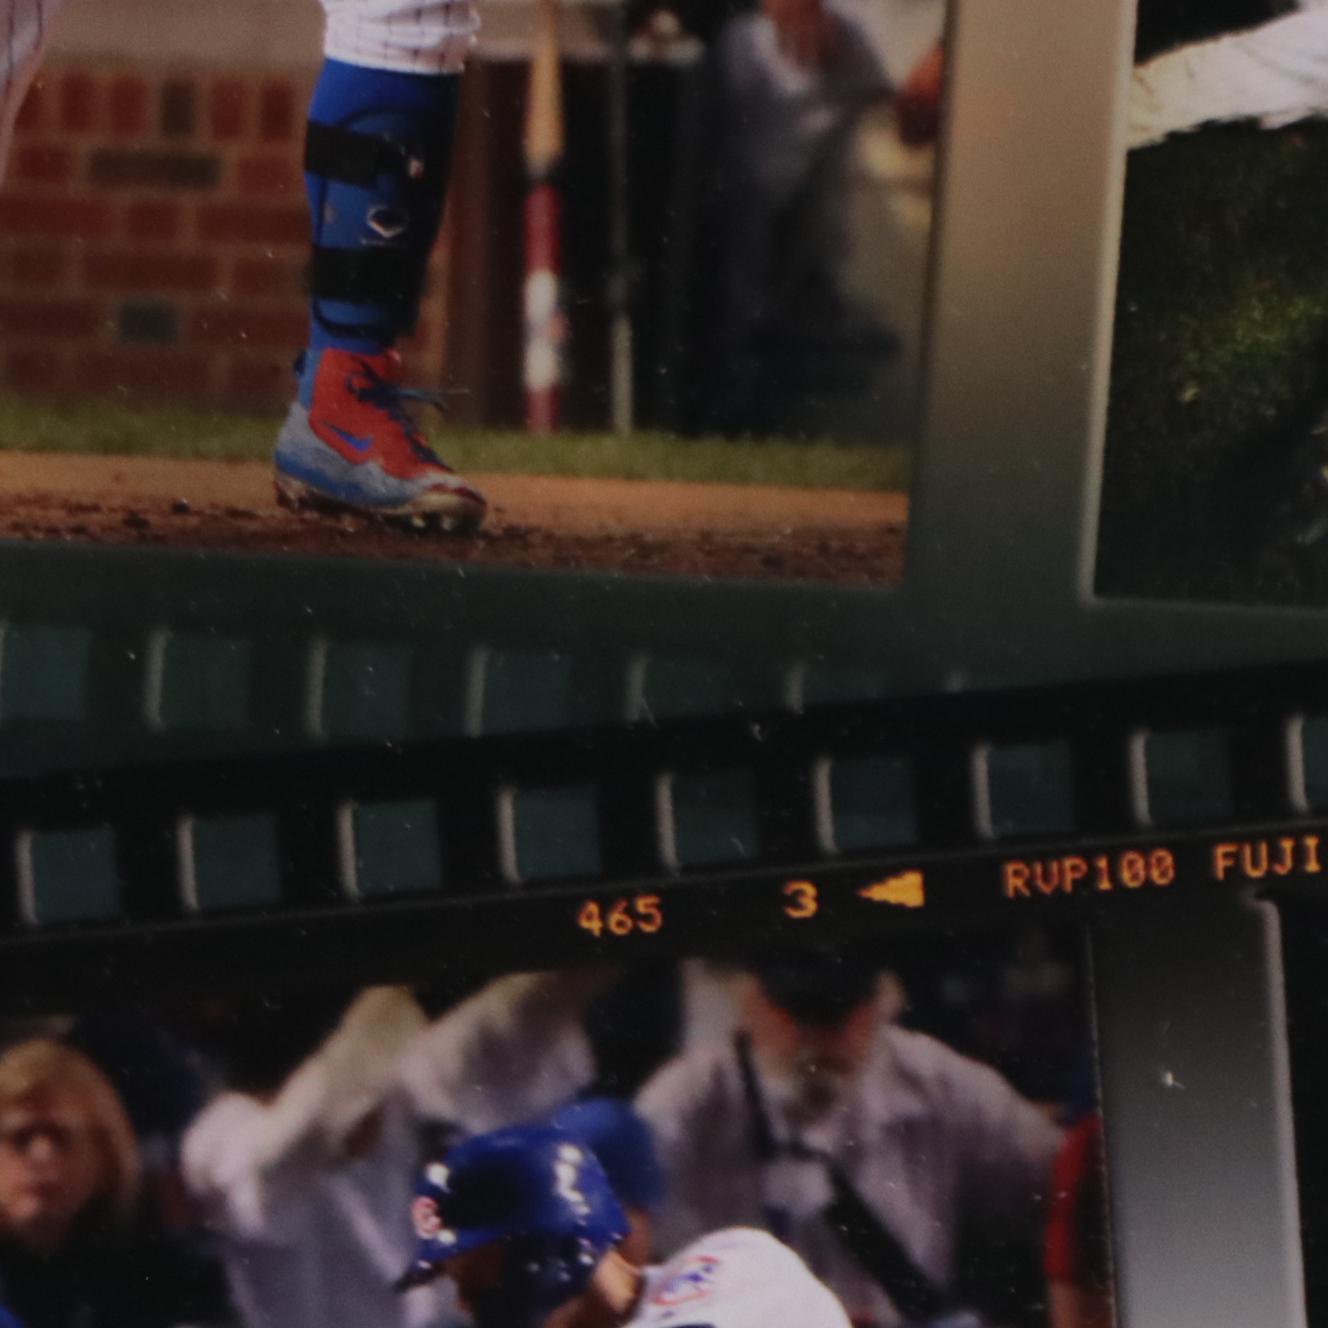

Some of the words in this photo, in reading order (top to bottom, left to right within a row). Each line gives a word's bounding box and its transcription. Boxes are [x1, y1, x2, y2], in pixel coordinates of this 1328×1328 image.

[577, 894, 664, 937] 465
[783, 879, 819, 919] 3
[1002, 847, 1177, 898] RVP100
[1212, 835, 1323, 880] FUJI
